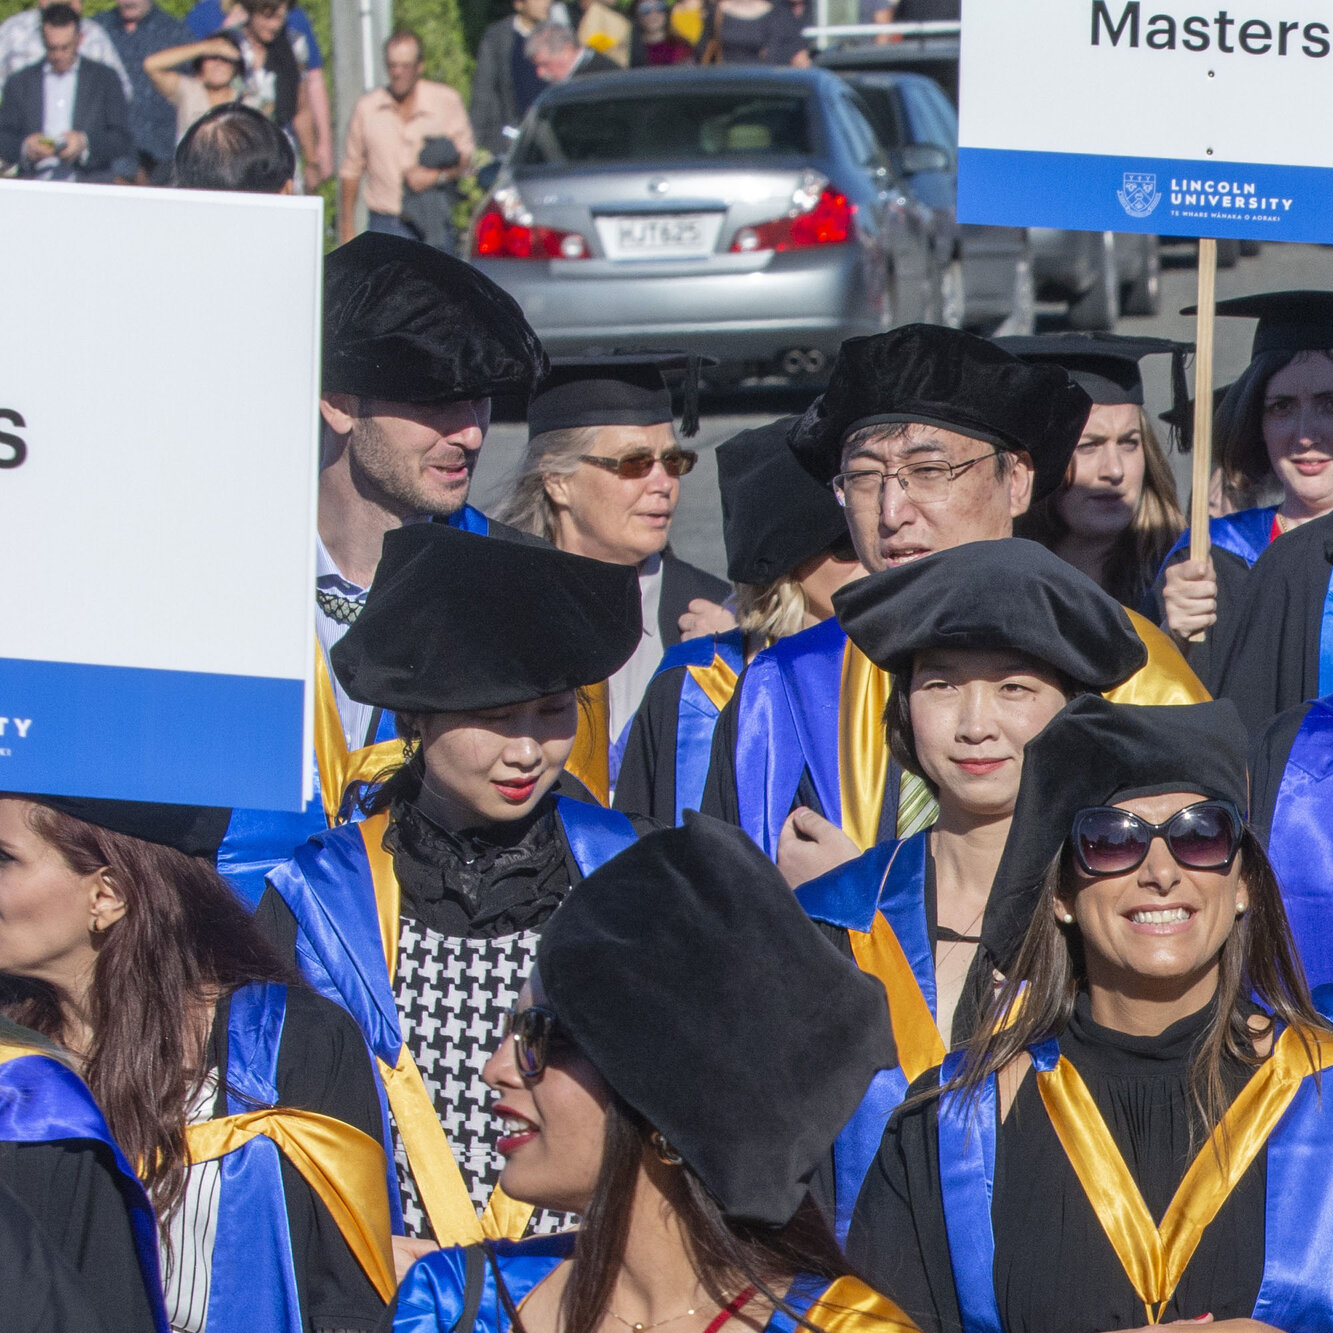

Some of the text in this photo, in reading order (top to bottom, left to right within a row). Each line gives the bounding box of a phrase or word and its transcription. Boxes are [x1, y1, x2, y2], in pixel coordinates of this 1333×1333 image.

[1091, 0, 1331, 58] Masters
[1171, 178, 1255, 194] LINCOLN
[1171, 193, 1293, 211] UNIVERSITY
